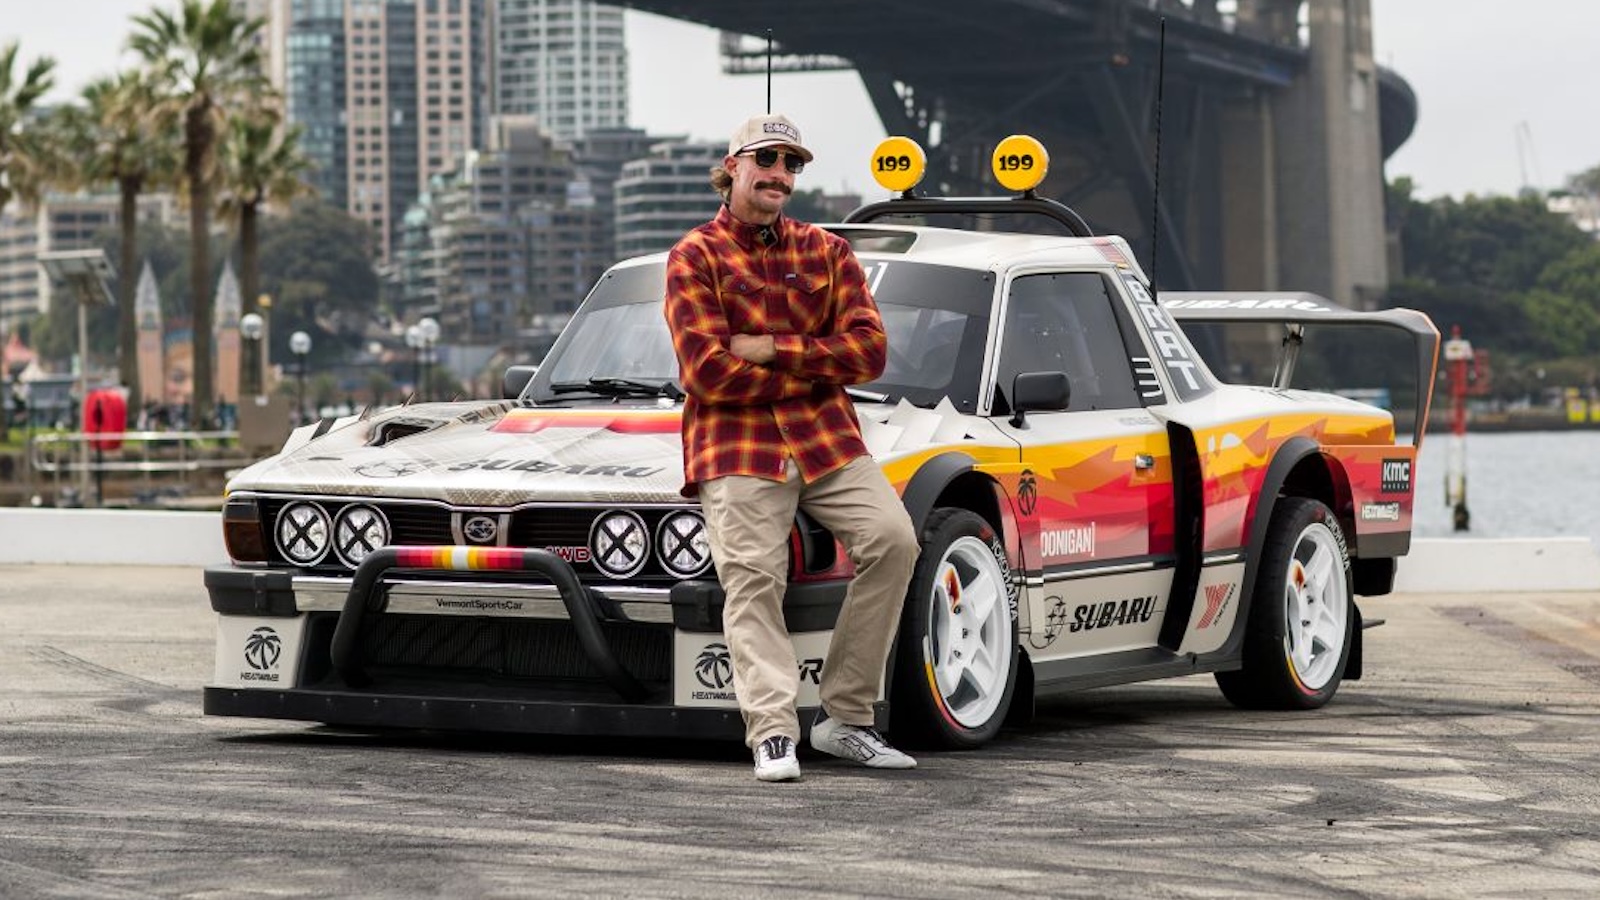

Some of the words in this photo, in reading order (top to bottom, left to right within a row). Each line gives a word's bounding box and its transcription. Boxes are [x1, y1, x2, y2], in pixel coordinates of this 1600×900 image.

[876, 155, 911, 172] 199
[999, 154, 1034, 171] 199
[1161, 299, 1332, 312] UBARU
[1125, 280, 1201, 390] BRAT
[447, 459, 666, 478] SUBARU
[1041, 521, 1095, 557] OONIGAN]
[991, 536, 1018, 621] YOKOHAMA
[436, 598, 524, 611] VermontSportsCar
[1070, 595, 1158, 632] SUBARU
